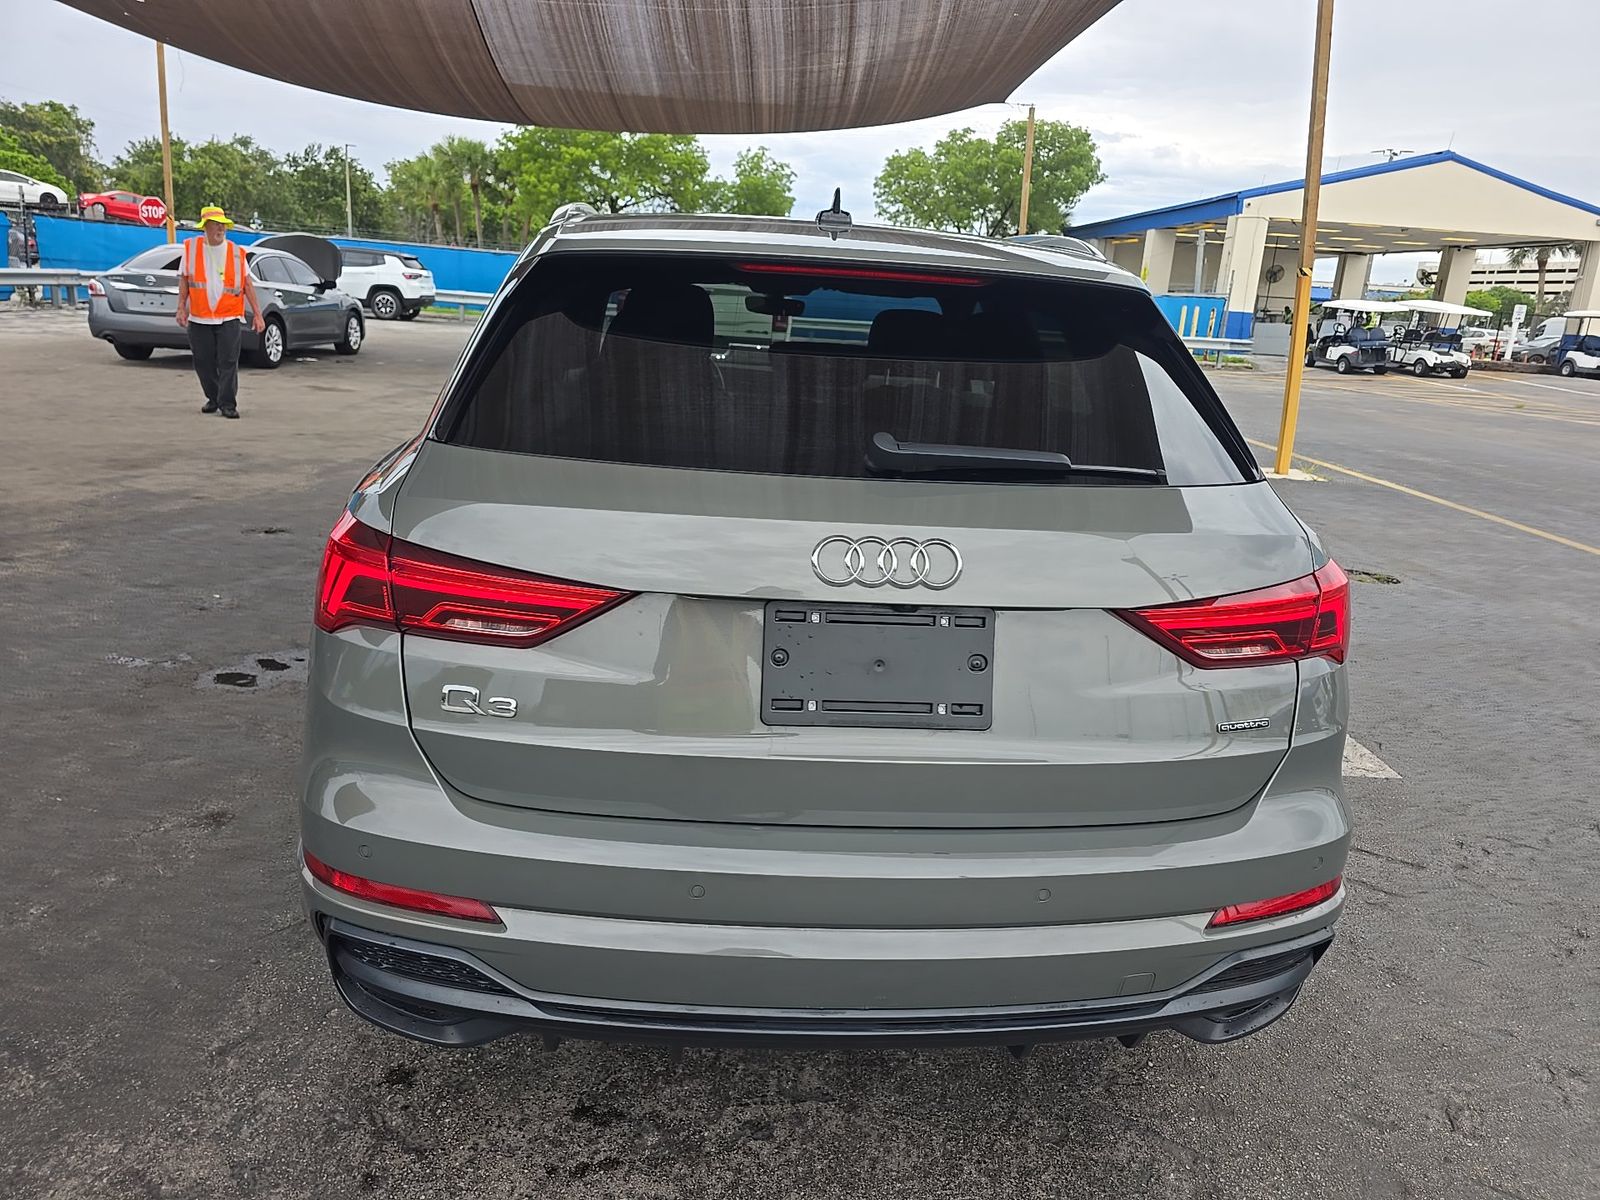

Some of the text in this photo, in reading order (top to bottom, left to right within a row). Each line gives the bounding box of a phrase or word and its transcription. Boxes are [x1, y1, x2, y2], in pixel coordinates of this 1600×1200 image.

[141, 205, 165, 218] STOP
[440, 684, 517, 718] Q3
[1220, 720, 1269, 732] quattro
